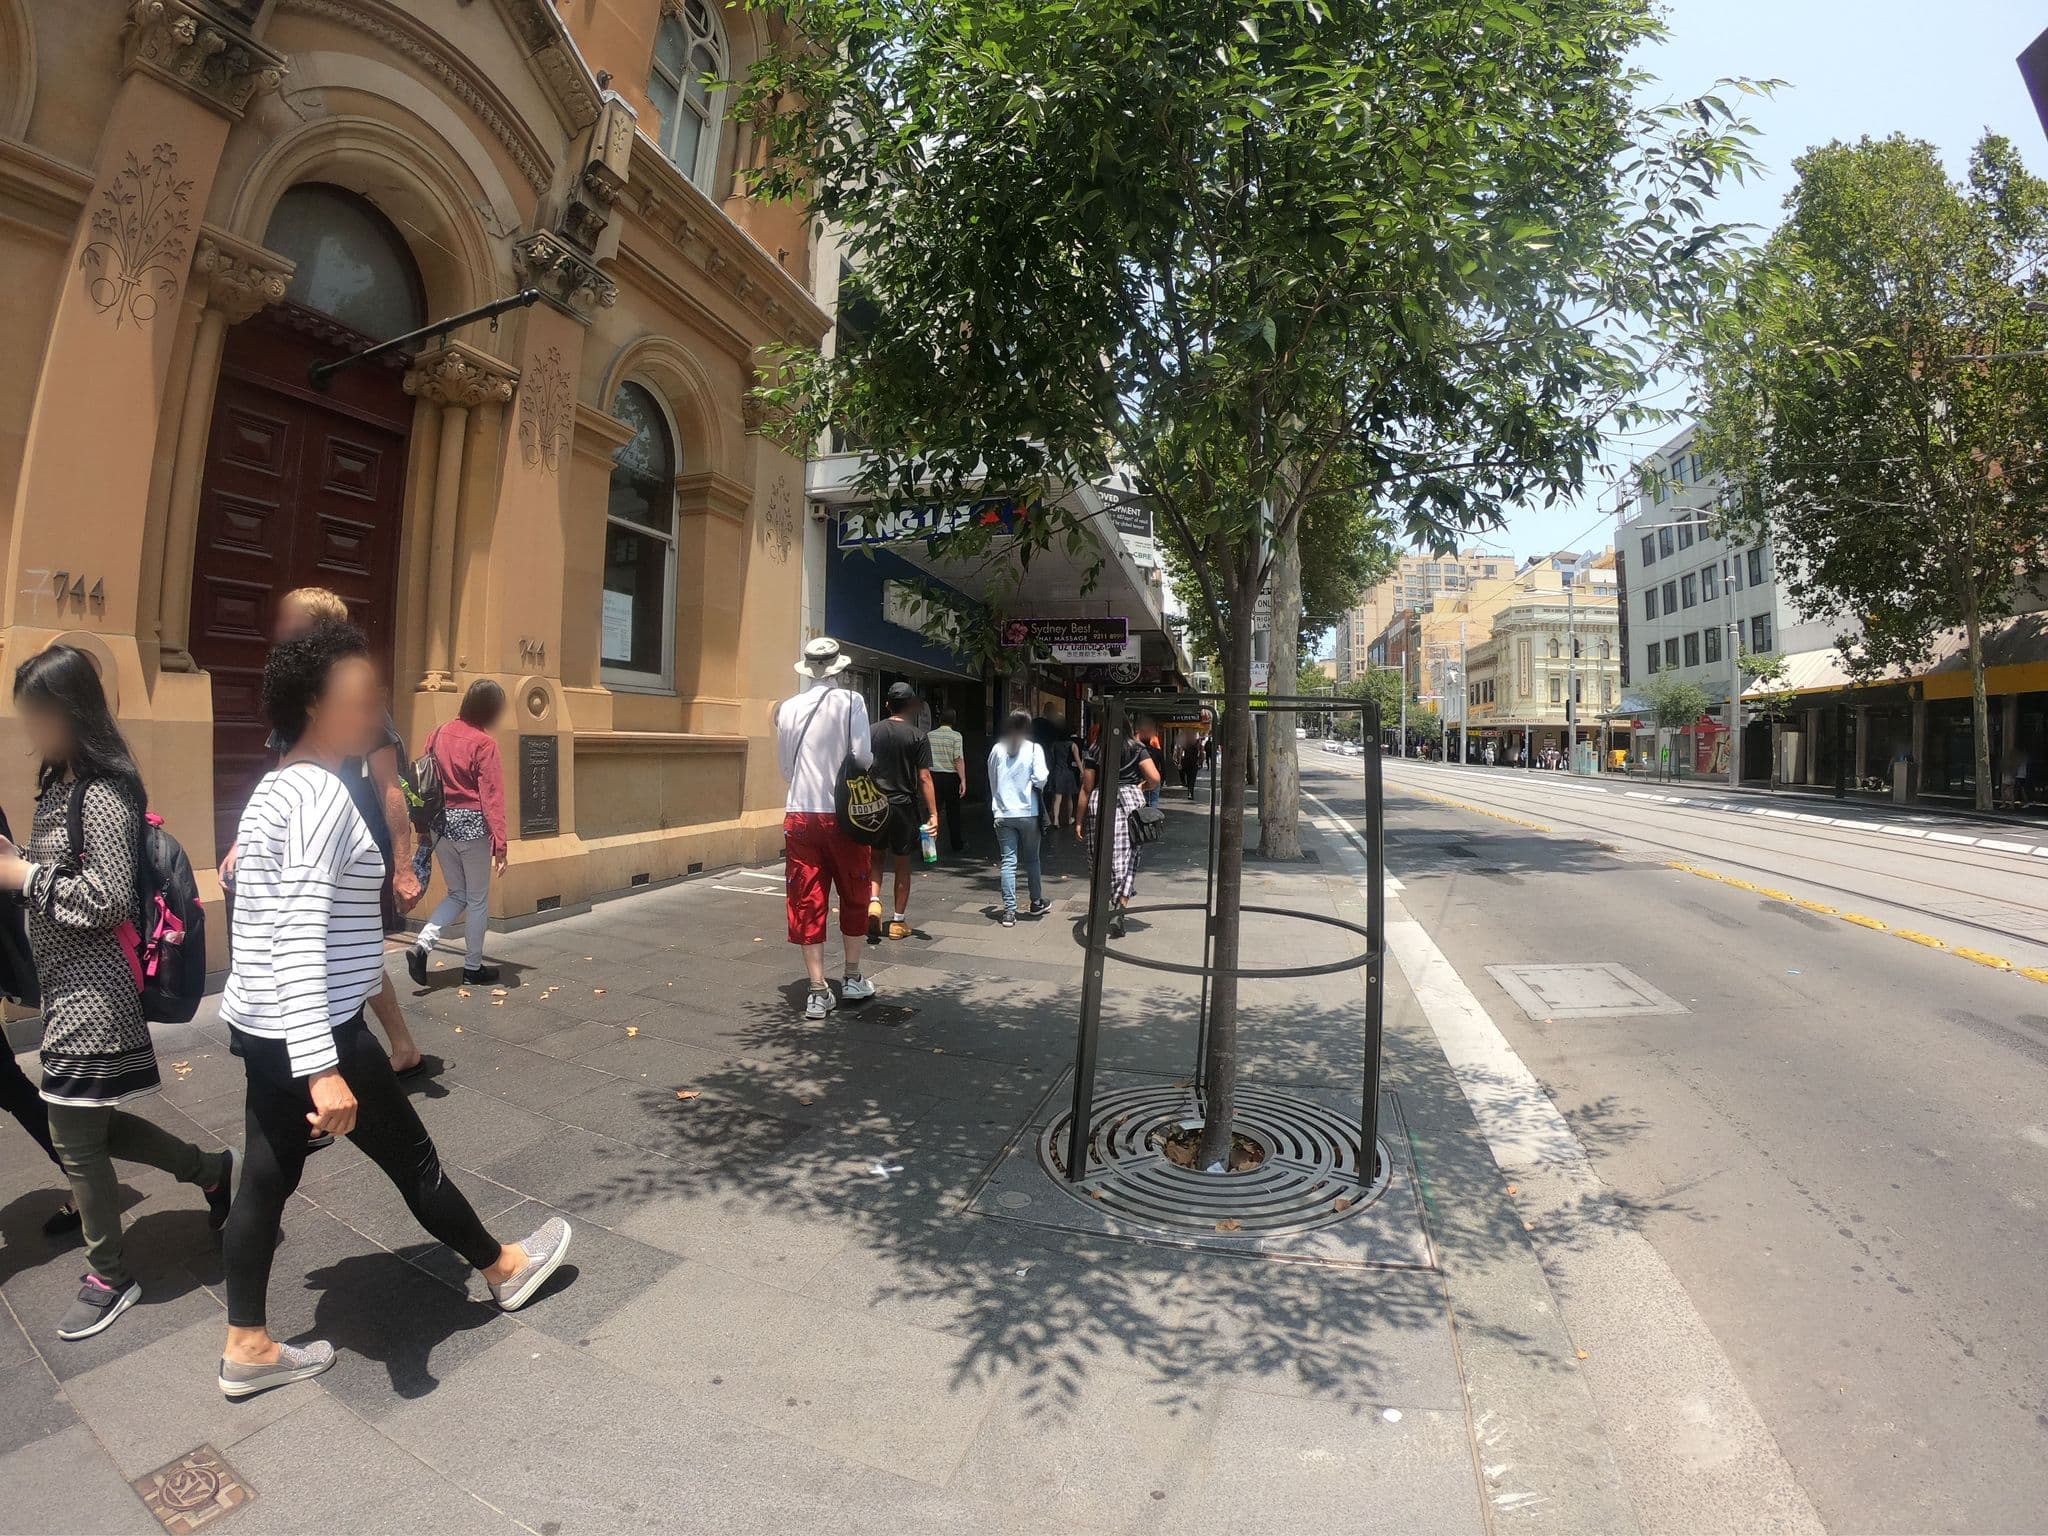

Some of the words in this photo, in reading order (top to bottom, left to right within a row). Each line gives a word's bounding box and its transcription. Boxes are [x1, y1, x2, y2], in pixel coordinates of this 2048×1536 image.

[847, 511, 919, 541] BNG
[53, 571, 104, 606] 744
[1031, 622, 1067, 638] Sydney
[1071, 622, 1091, 633] Best
[1054, 634, 1088, 642] MASSAGE
